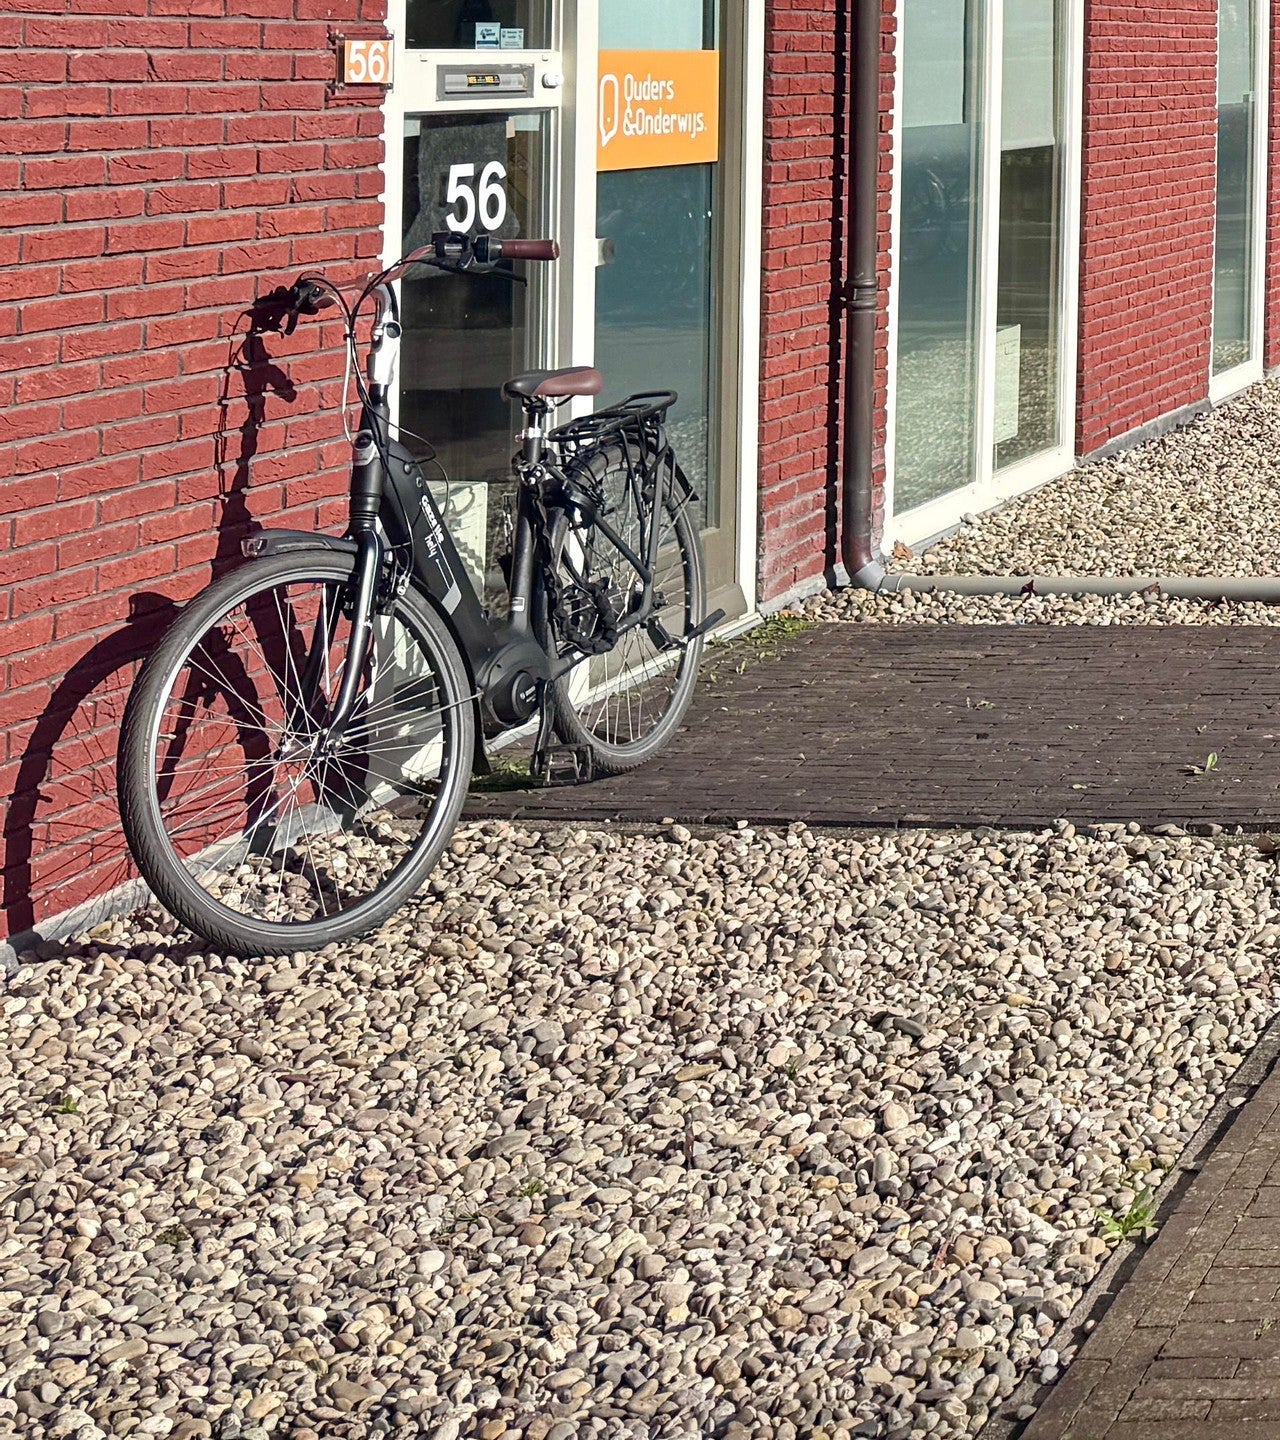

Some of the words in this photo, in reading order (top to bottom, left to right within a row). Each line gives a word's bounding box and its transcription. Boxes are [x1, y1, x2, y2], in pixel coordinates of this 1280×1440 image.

[349, 41, 386, 83] 56
[623, 73, 675, 101] Ouders
[446, 160, 507, 234] 56
